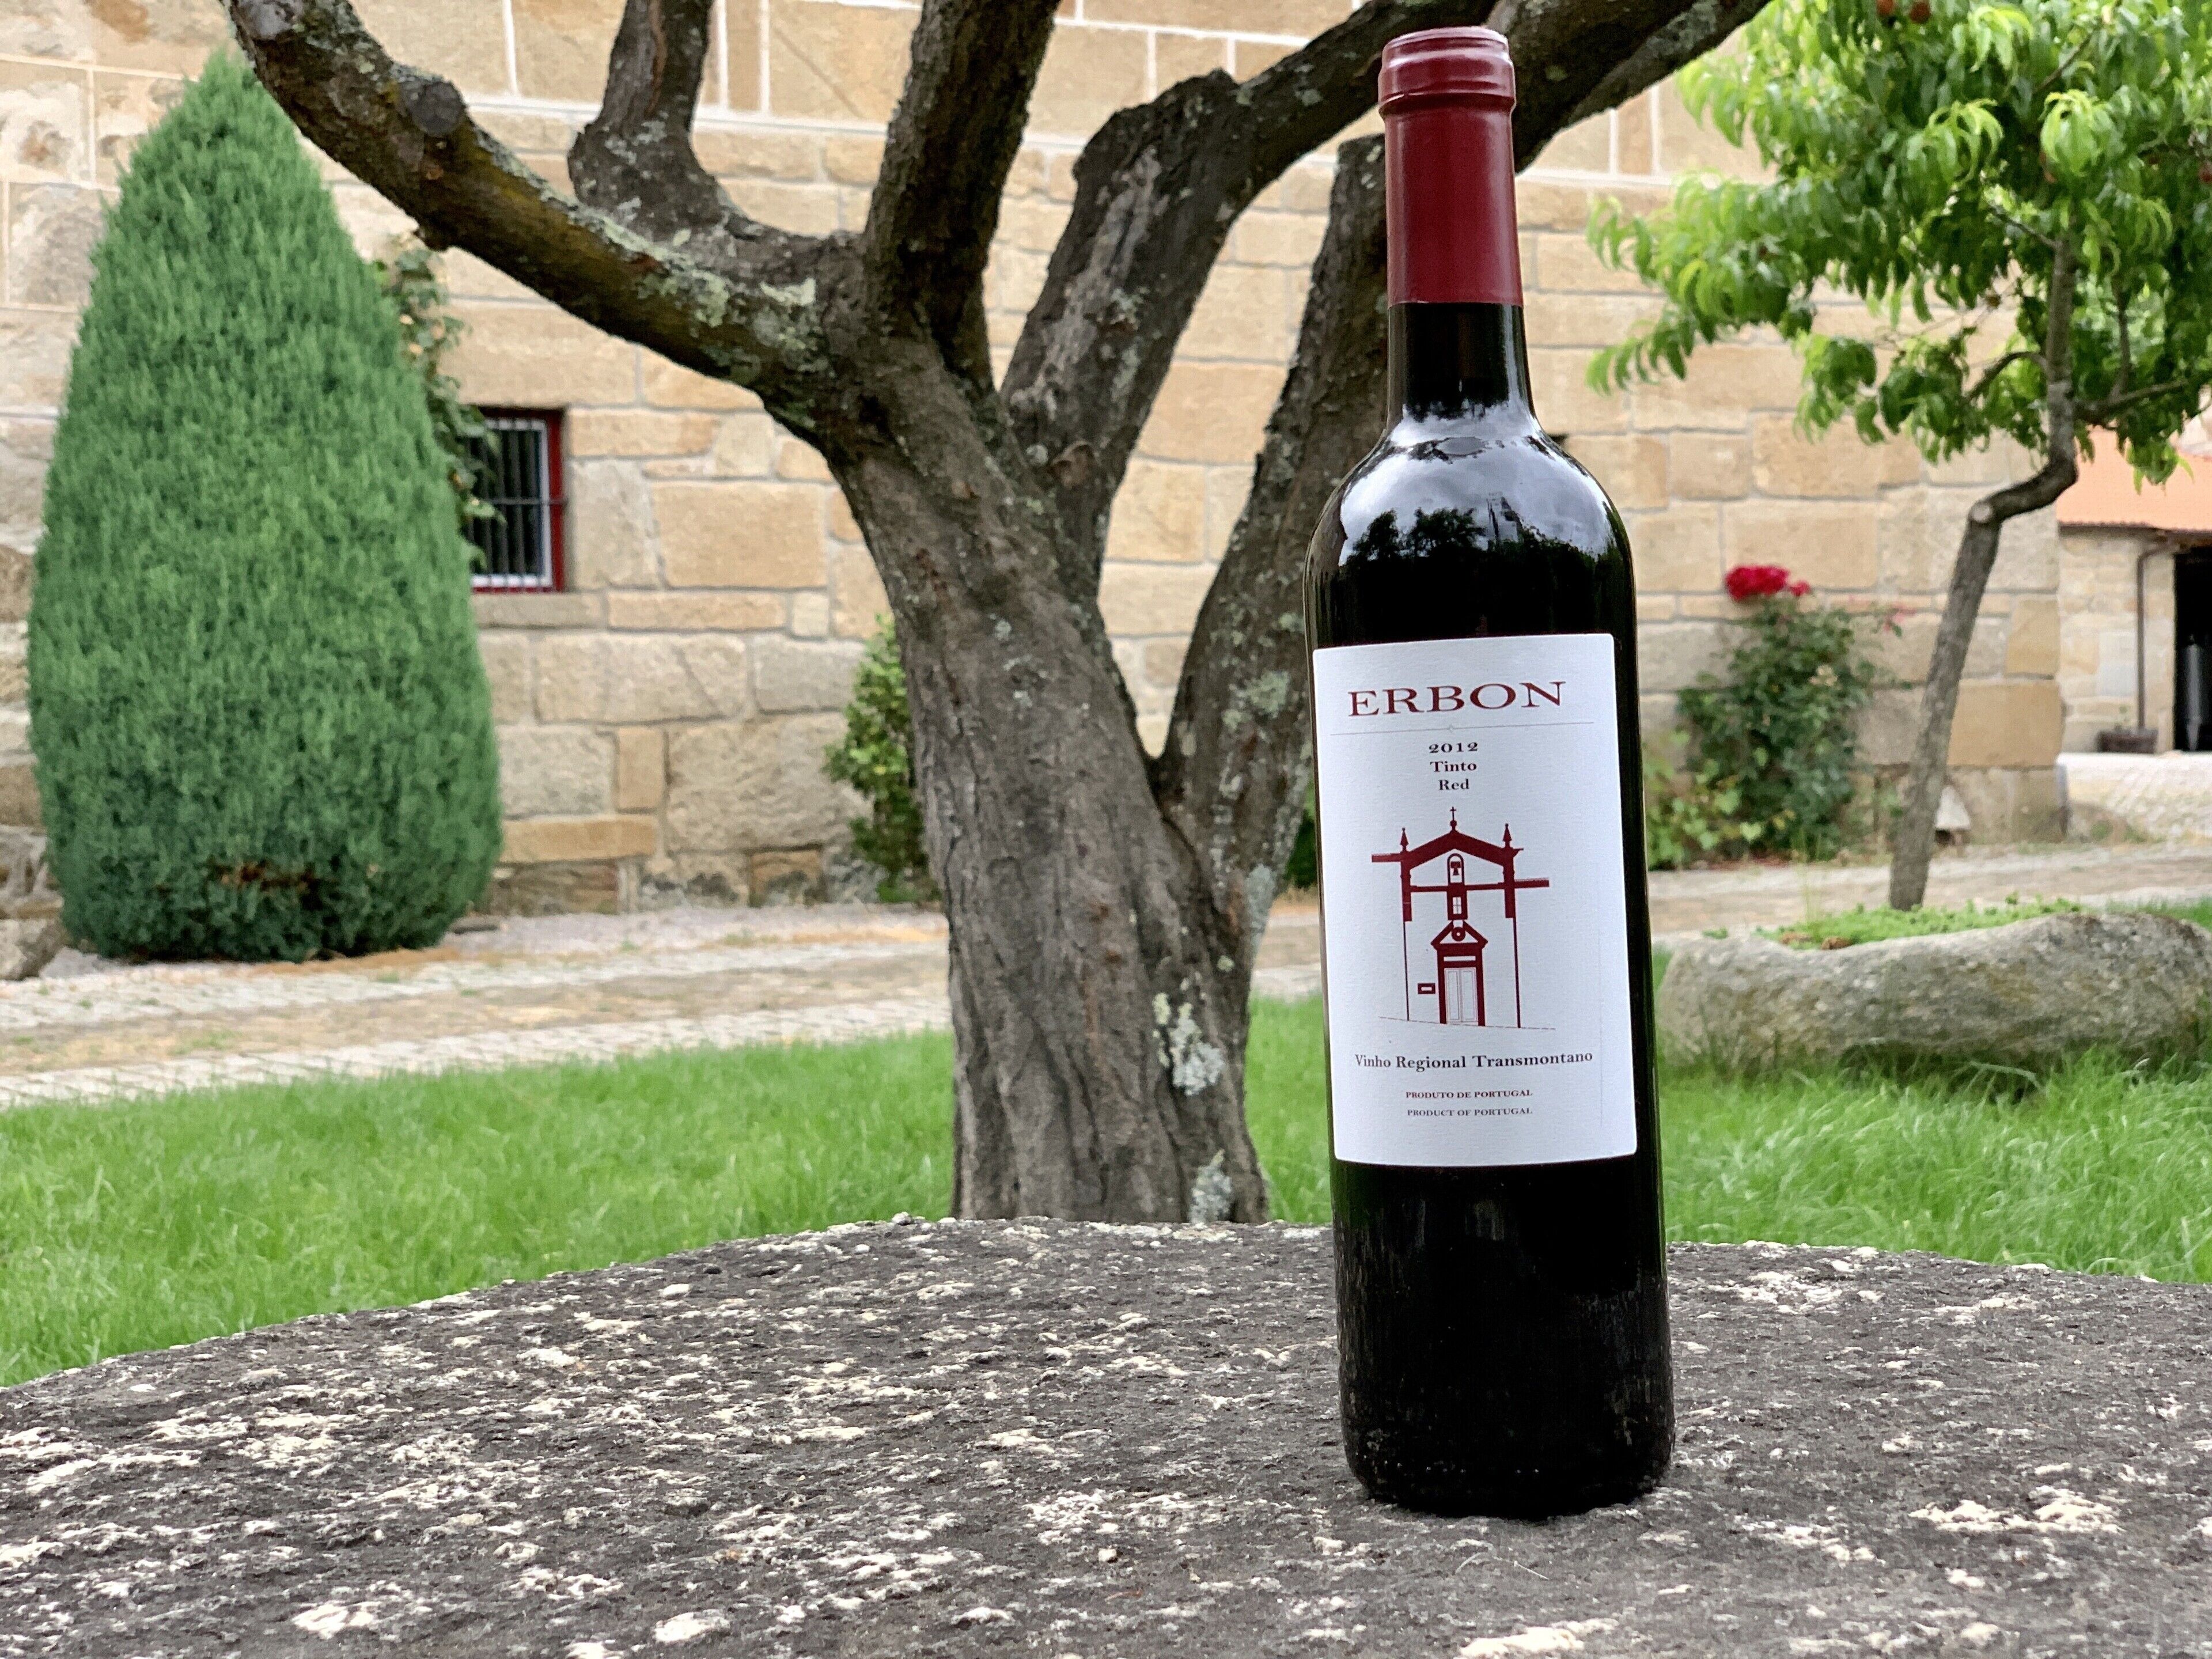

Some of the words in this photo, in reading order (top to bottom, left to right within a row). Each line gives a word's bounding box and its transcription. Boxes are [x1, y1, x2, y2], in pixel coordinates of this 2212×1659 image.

[1348, 681, 1566, 717] ERBON
[1428, 741, 1478, 753] 2012
[1429, 760, 1477, 772] Tinto
[1438, 778, 1469, 791] Red
[1355, 1054, 1391, 1068] Vinho
[1395, 1055, 1467, 1072] Regional
[1472, 1051, 1593, 1068] Transmontano
[1406, 1091, 1454, 1099] PRODUTO
[1474, 1089, 1533, 1098] PORTUGAL
[1407, 1109, 1455, 1117] PRODUCT
[1474, 1107, 1533, 1116] PORTUGAL
